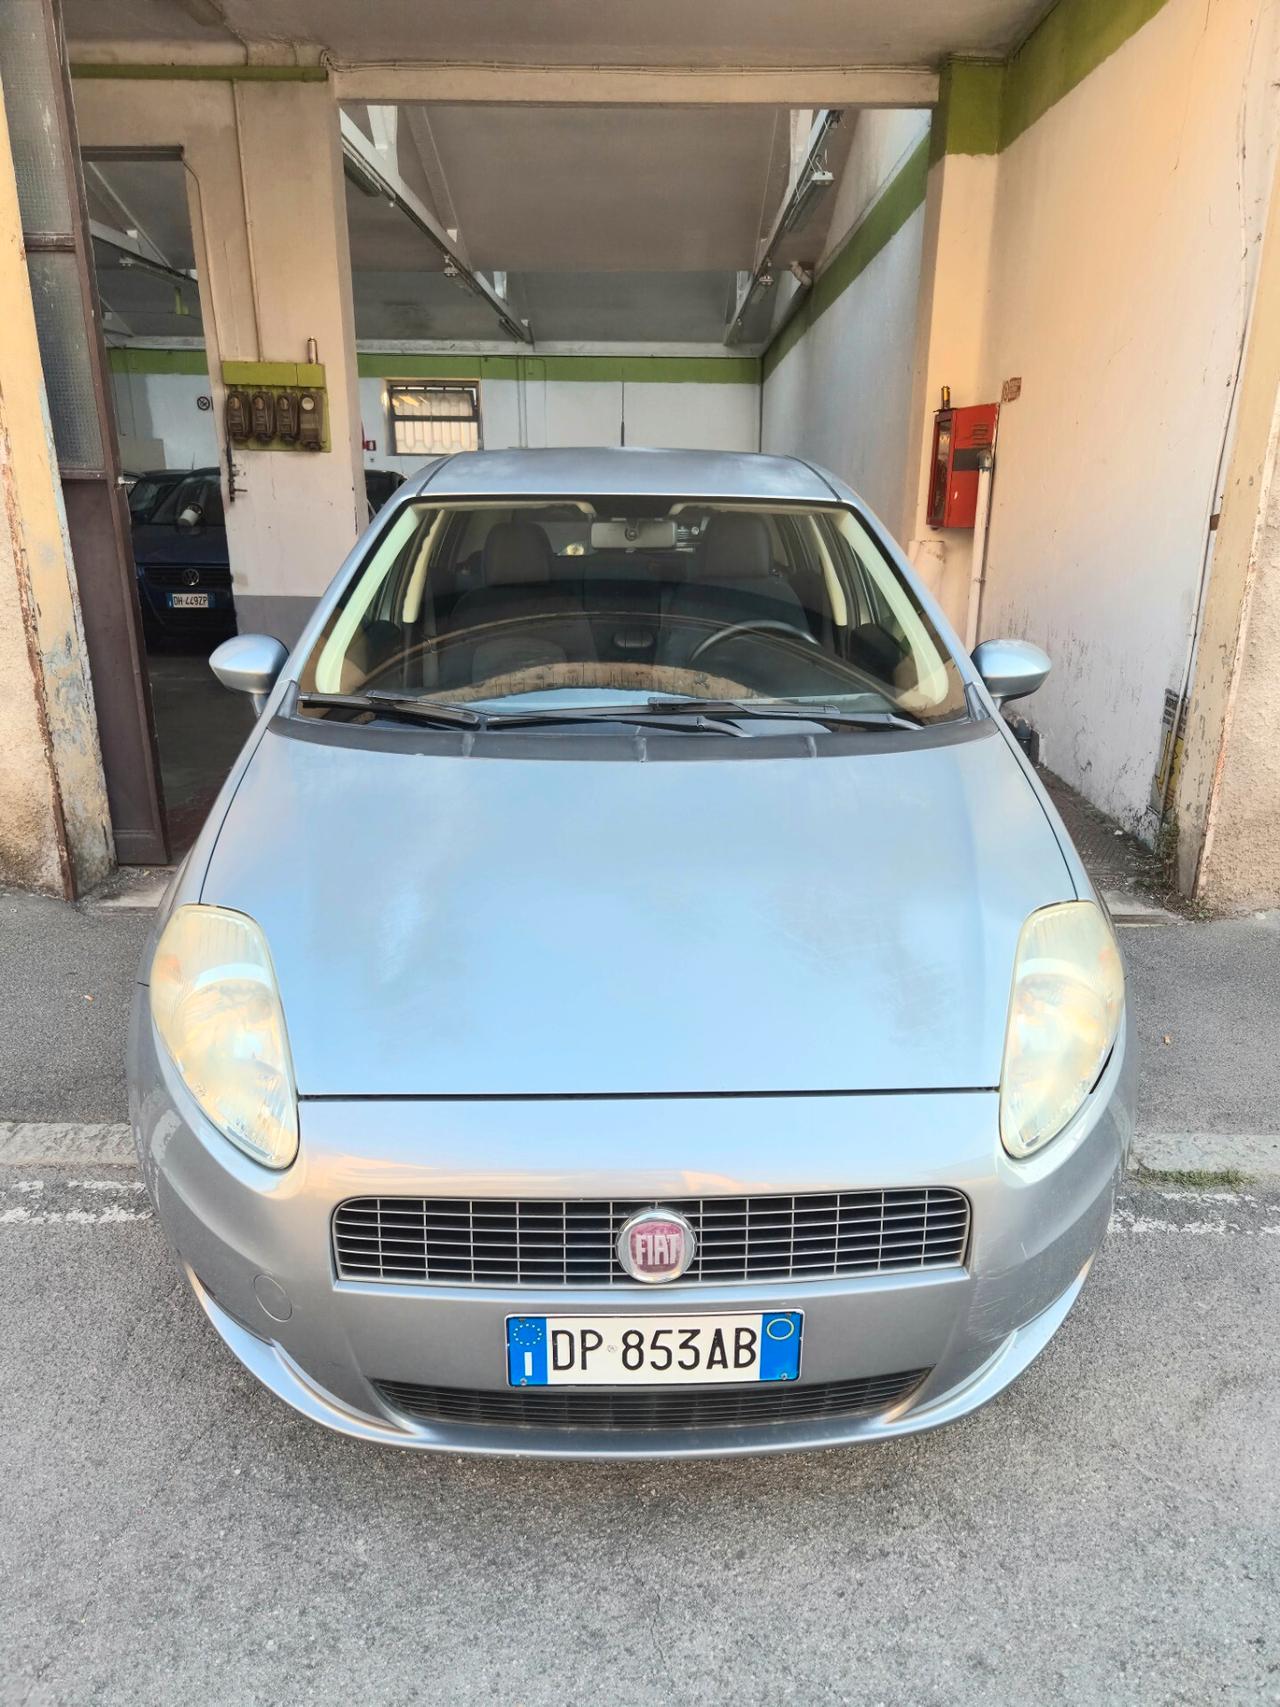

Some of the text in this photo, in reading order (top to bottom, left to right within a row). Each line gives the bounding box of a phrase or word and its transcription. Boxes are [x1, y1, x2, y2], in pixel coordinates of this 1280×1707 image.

[636, 1233, 680, 1265] FIAT
[552, 1327, 757, 1371] DP 853AB
